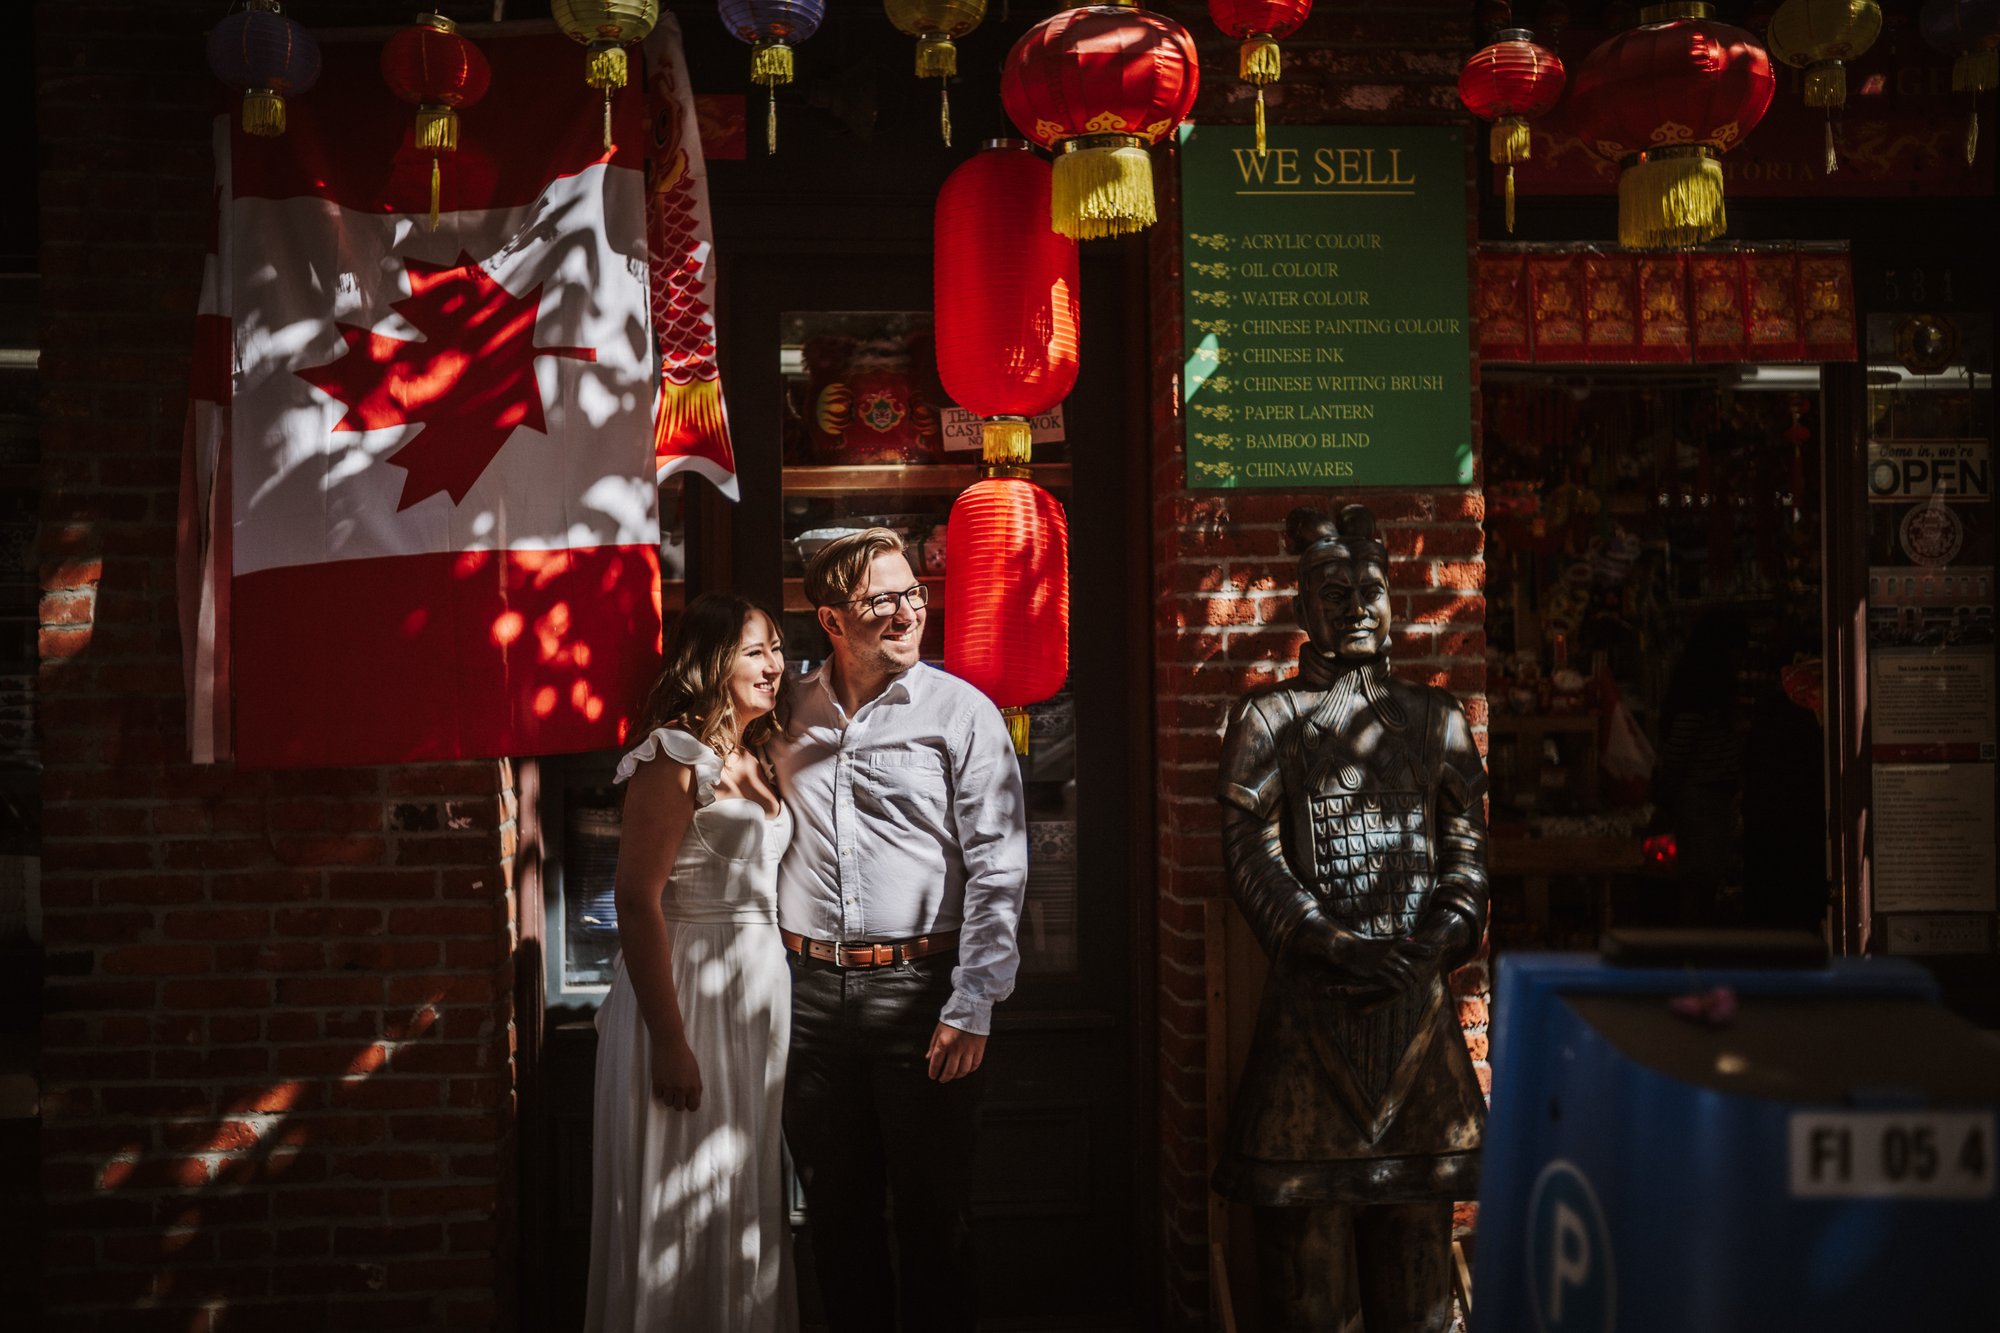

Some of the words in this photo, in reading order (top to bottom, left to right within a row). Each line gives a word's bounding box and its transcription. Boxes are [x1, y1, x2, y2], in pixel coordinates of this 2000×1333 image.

[1232, 148, 1301, 185] WE
[1313, 148, 1416, 185] SELL
[1240, 233, 1312, 249] ACRYLIC
[1315, 233, 1382, 249] COLOUR
[1240, 262, 1268, 278] OIL
[1272, 262, 1339, 278] COLOUR
[1242, 291, 1299, 306] WATER
[1303, 291, 1370, 306] COLOUR
[1242, 319, 1311, 334] CHINESE
[1315, 319, 1391, 334] PAINTING
[1395, 318, 1461, 334] COLOUR
[1242, 348, 1312, 363] CHINESE
[1316, 348, 1345, 363] INK
[1243, 376, 1312, 392] CHINESE
[1316, 376, 1386, 391] WRITING
[1391, 375, 1445, 391] BRUSH
[1244, 405, 1296, 420] PAPER
[1300, 404, 1375, 420] LANTERN
[945, 422, 982, 438] CAST
[1246, 434, 1317, 449] BAMBOO
[1321, 433, 1370, 449] BLIND
[1879, 446, 1913, 457] Come
[1939, 443, 1974, 457] we're
[1246, 462, 1354, 477] CHINAWARES
[1868, 458, 1988, 495] OPEN
[1880, 1124, 1939, 1182] 05
[1548, 1198, 1592, 1325] P
